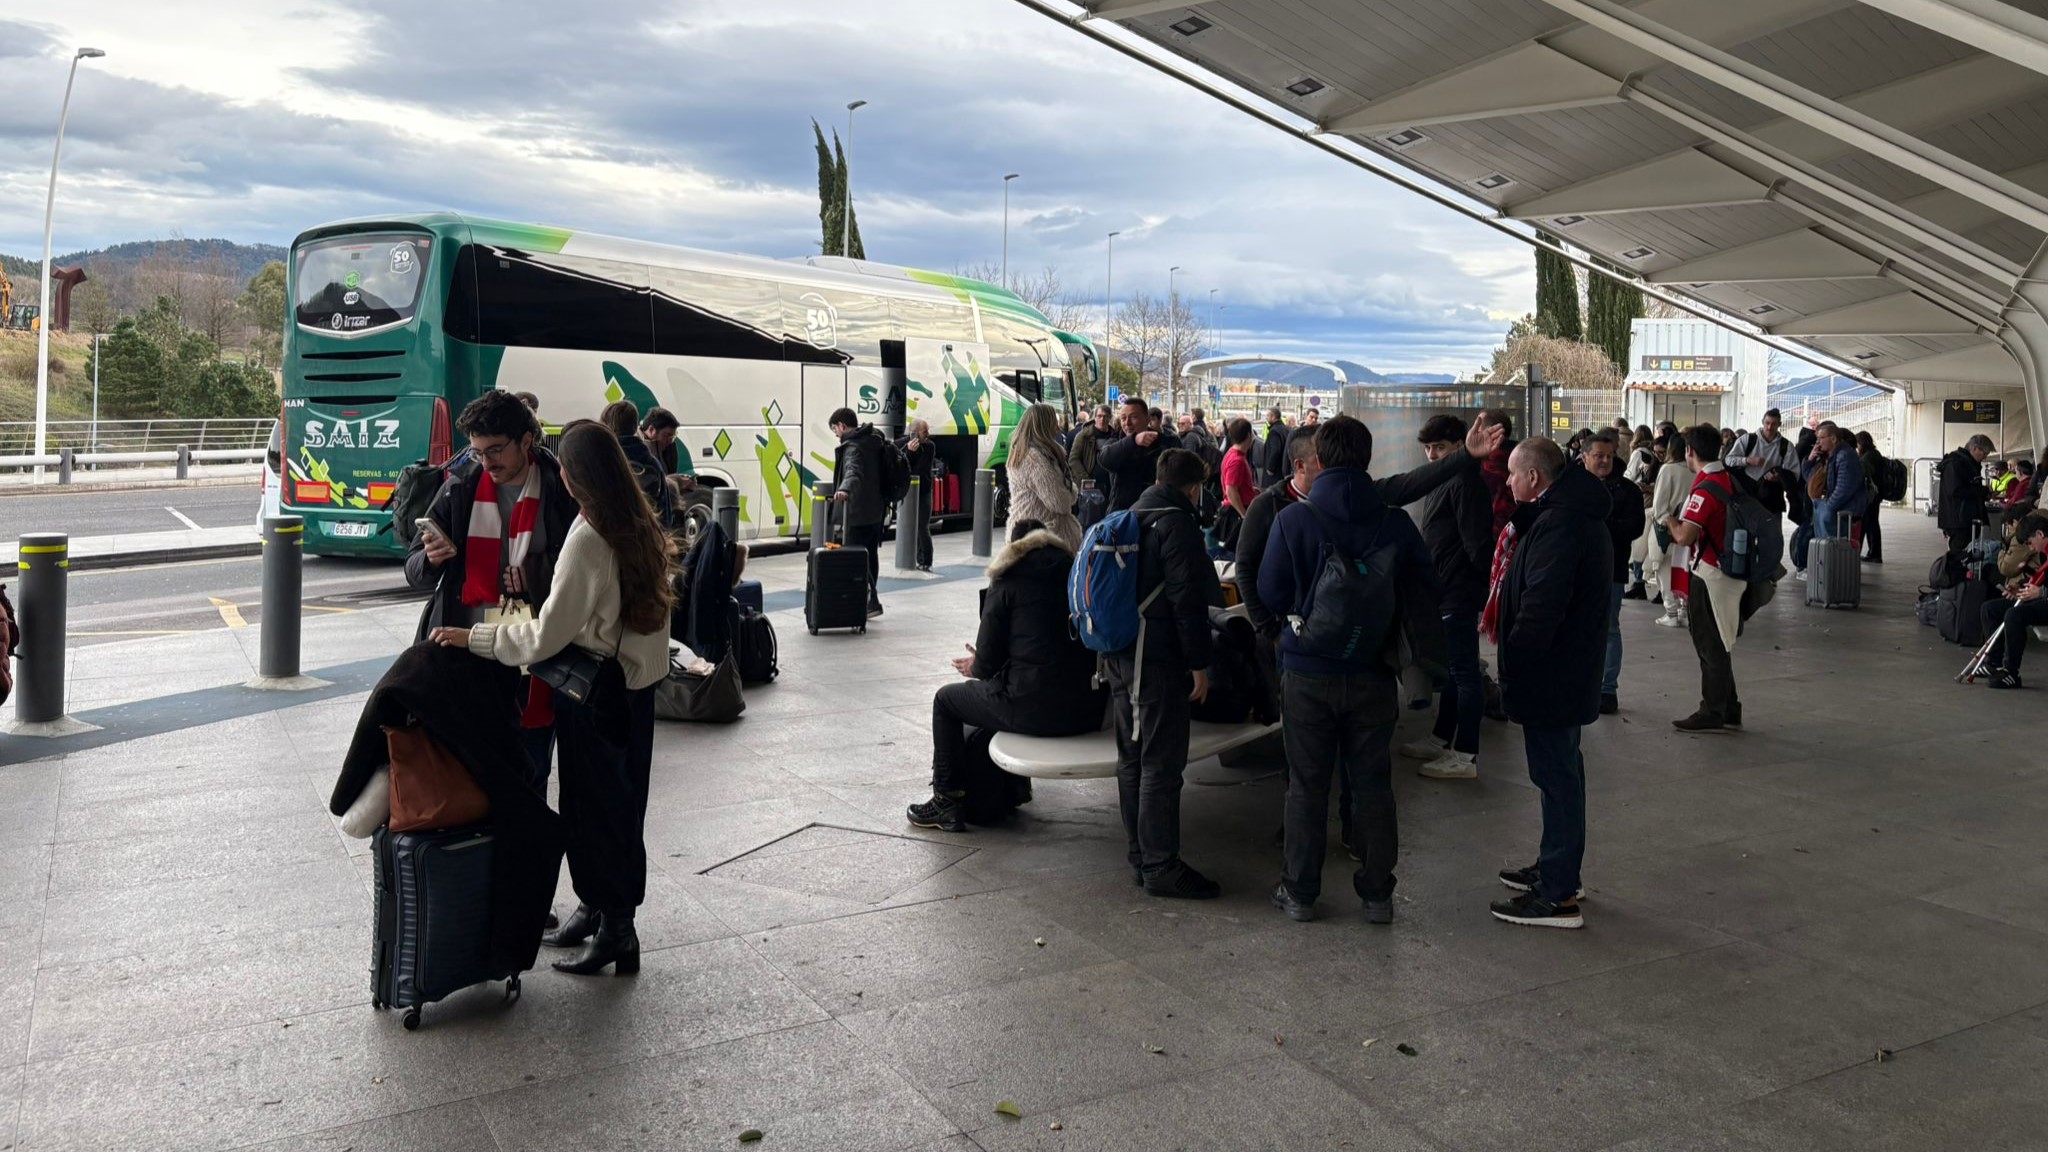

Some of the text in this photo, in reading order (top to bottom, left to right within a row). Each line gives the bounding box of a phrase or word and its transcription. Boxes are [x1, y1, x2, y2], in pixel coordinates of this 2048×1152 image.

[394, 251, 410, 262] 50
[344, 315, 371, 327] irizar
[807, 308, 829, 330] 50
[303, 419, 400, 449] SAIZ
[352, 469, 382, 478] RESERVAS
